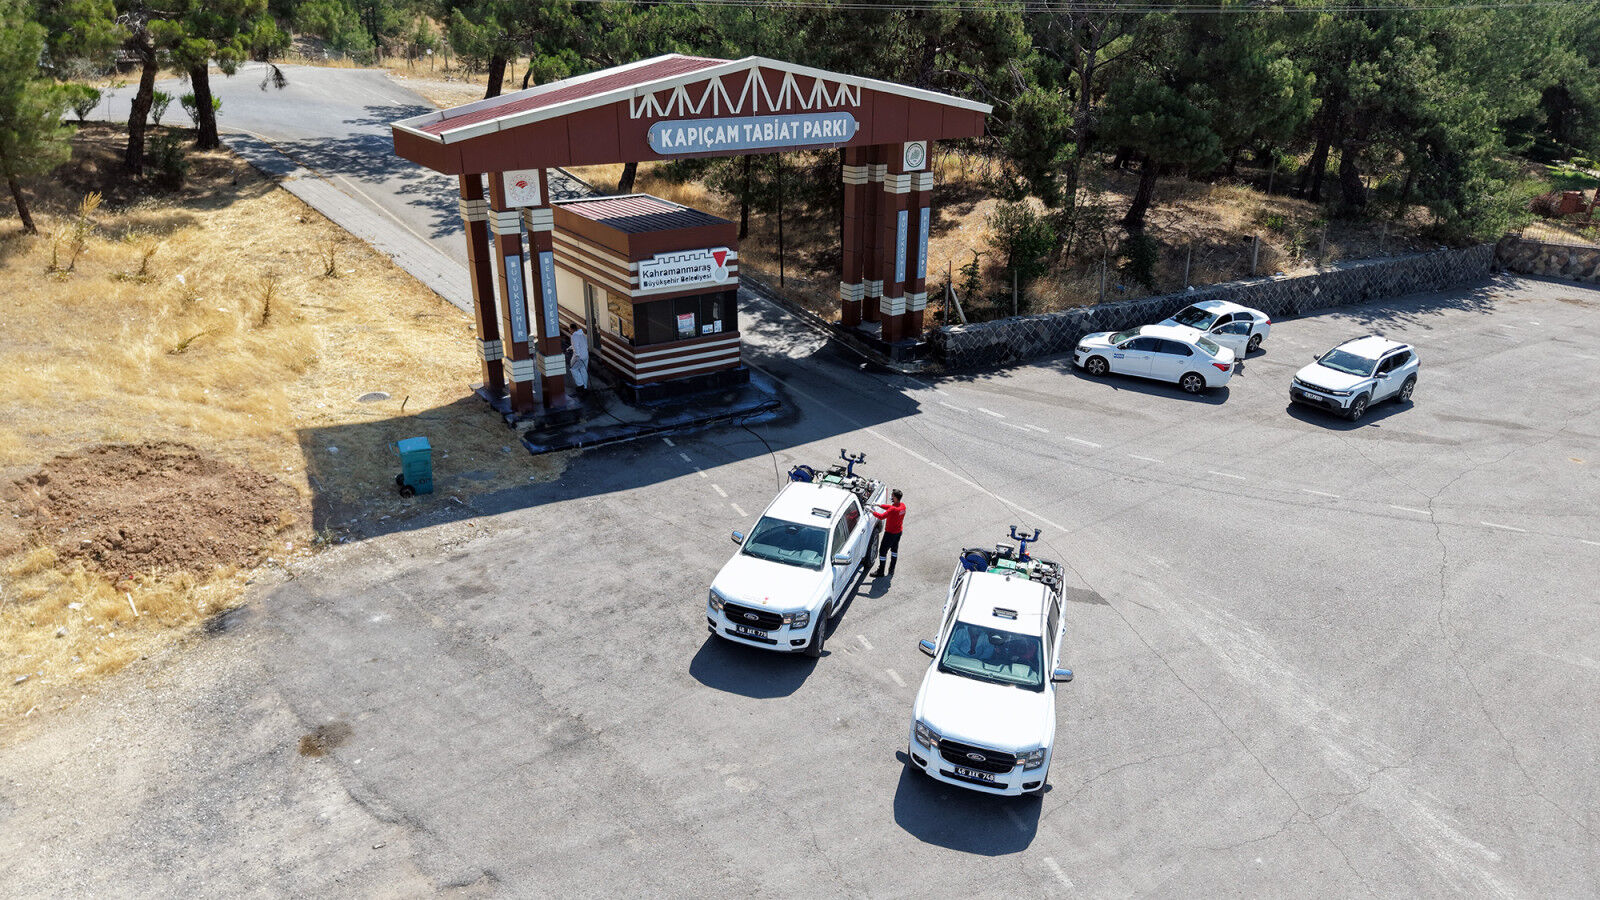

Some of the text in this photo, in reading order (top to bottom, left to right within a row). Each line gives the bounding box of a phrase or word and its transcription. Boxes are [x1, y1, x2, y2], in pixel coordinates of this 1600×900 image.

[661, 119, 848, 148] KAPIÇAM TABİAT PARKI
[642, 264, 712, 279] Kahramanmaraş
[643, 273, 712, 287] Büyükşehir Belediyesi
